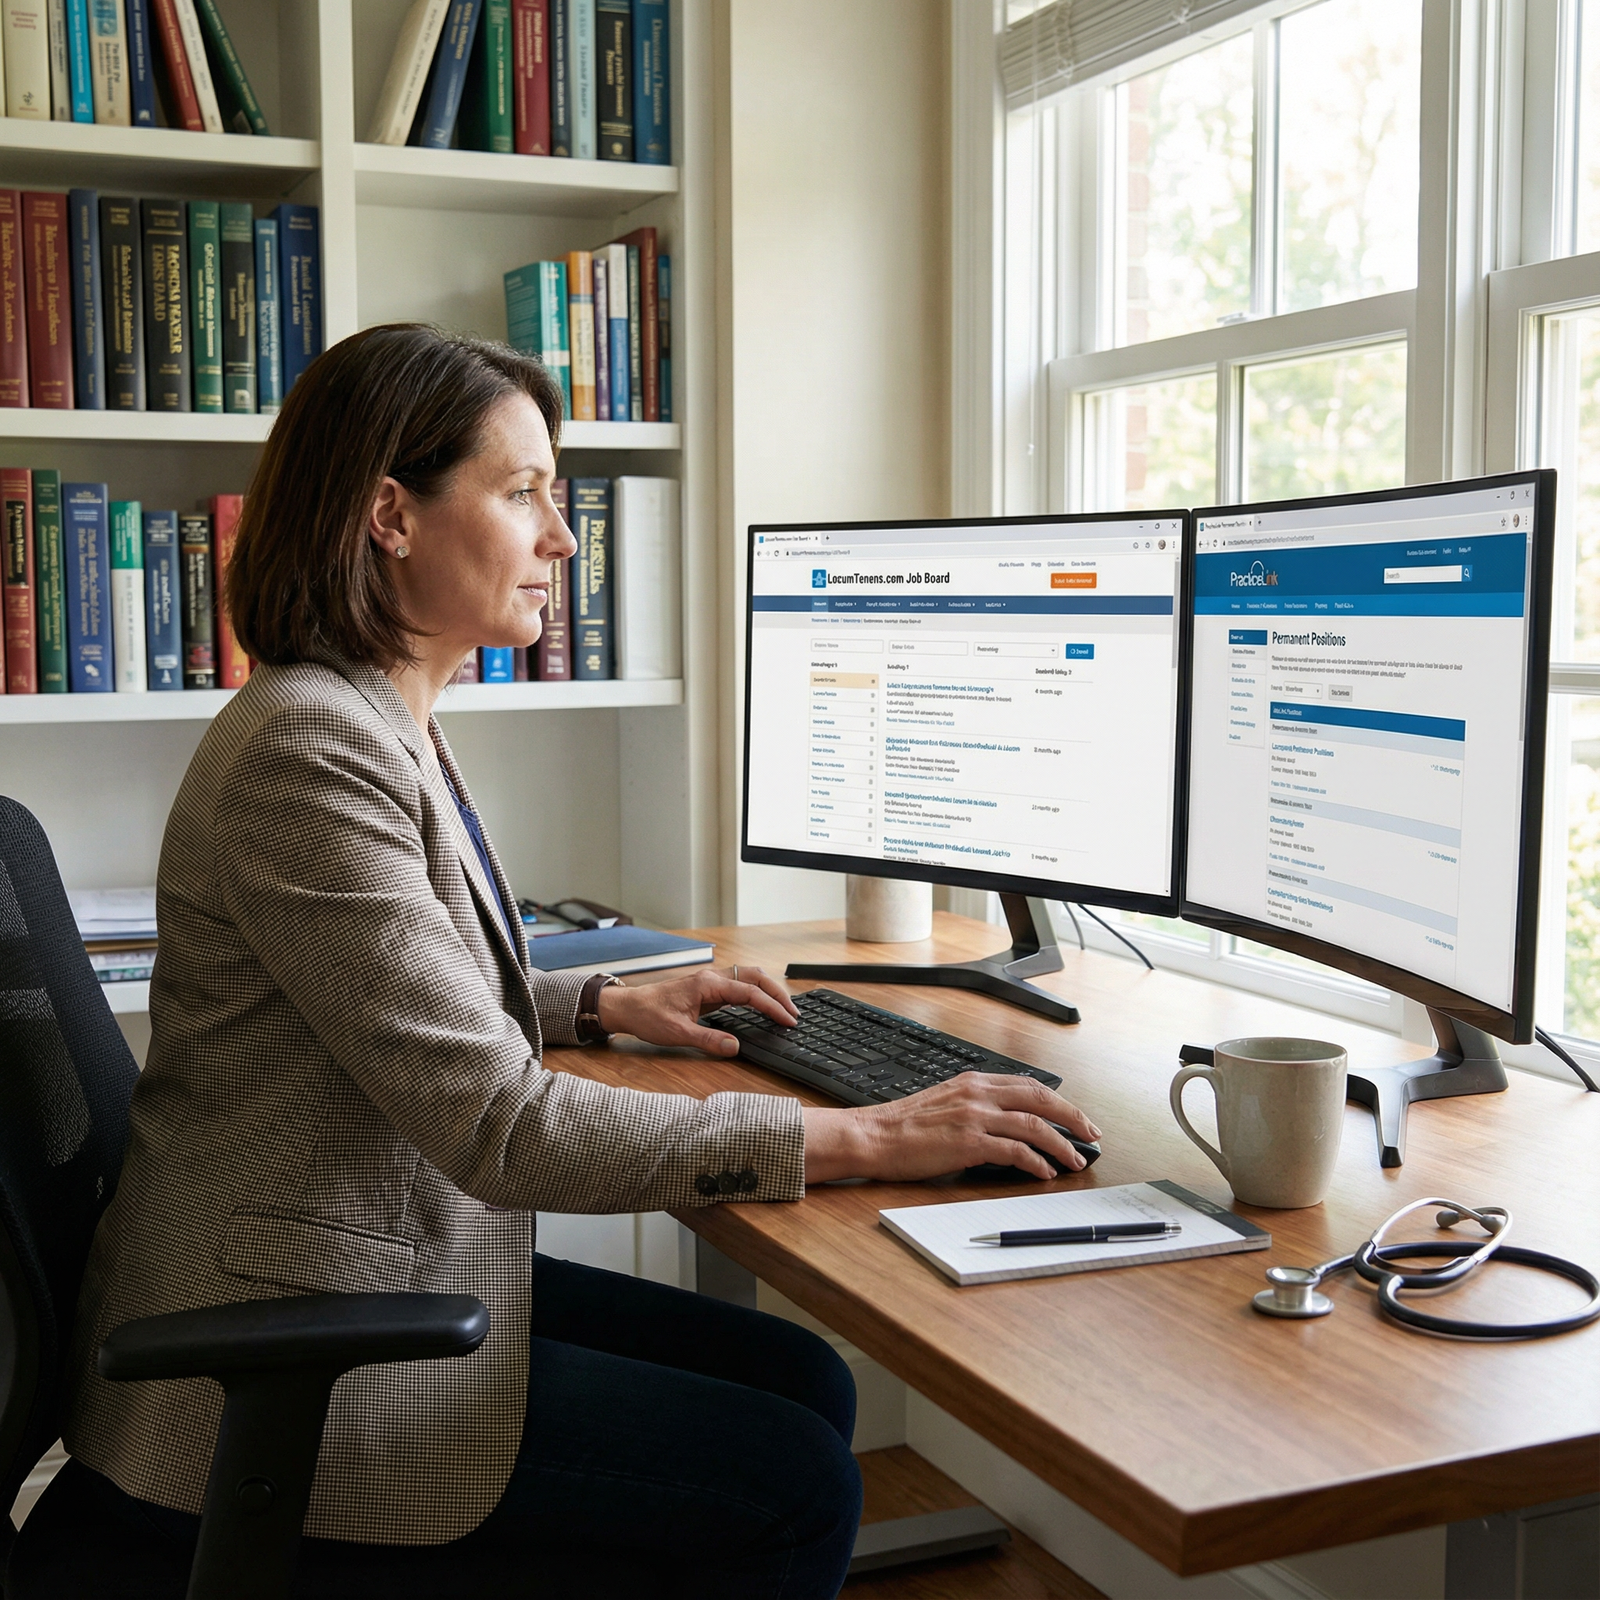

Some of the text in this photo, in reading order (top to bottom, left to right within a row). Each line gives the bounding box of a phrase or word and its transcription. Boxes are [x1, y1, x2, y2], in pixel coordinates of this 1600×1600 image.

[827, 572, 950, 584] LocumTenens.com Job Board
[1272, 631, 1347, 647] Permanent Positions
